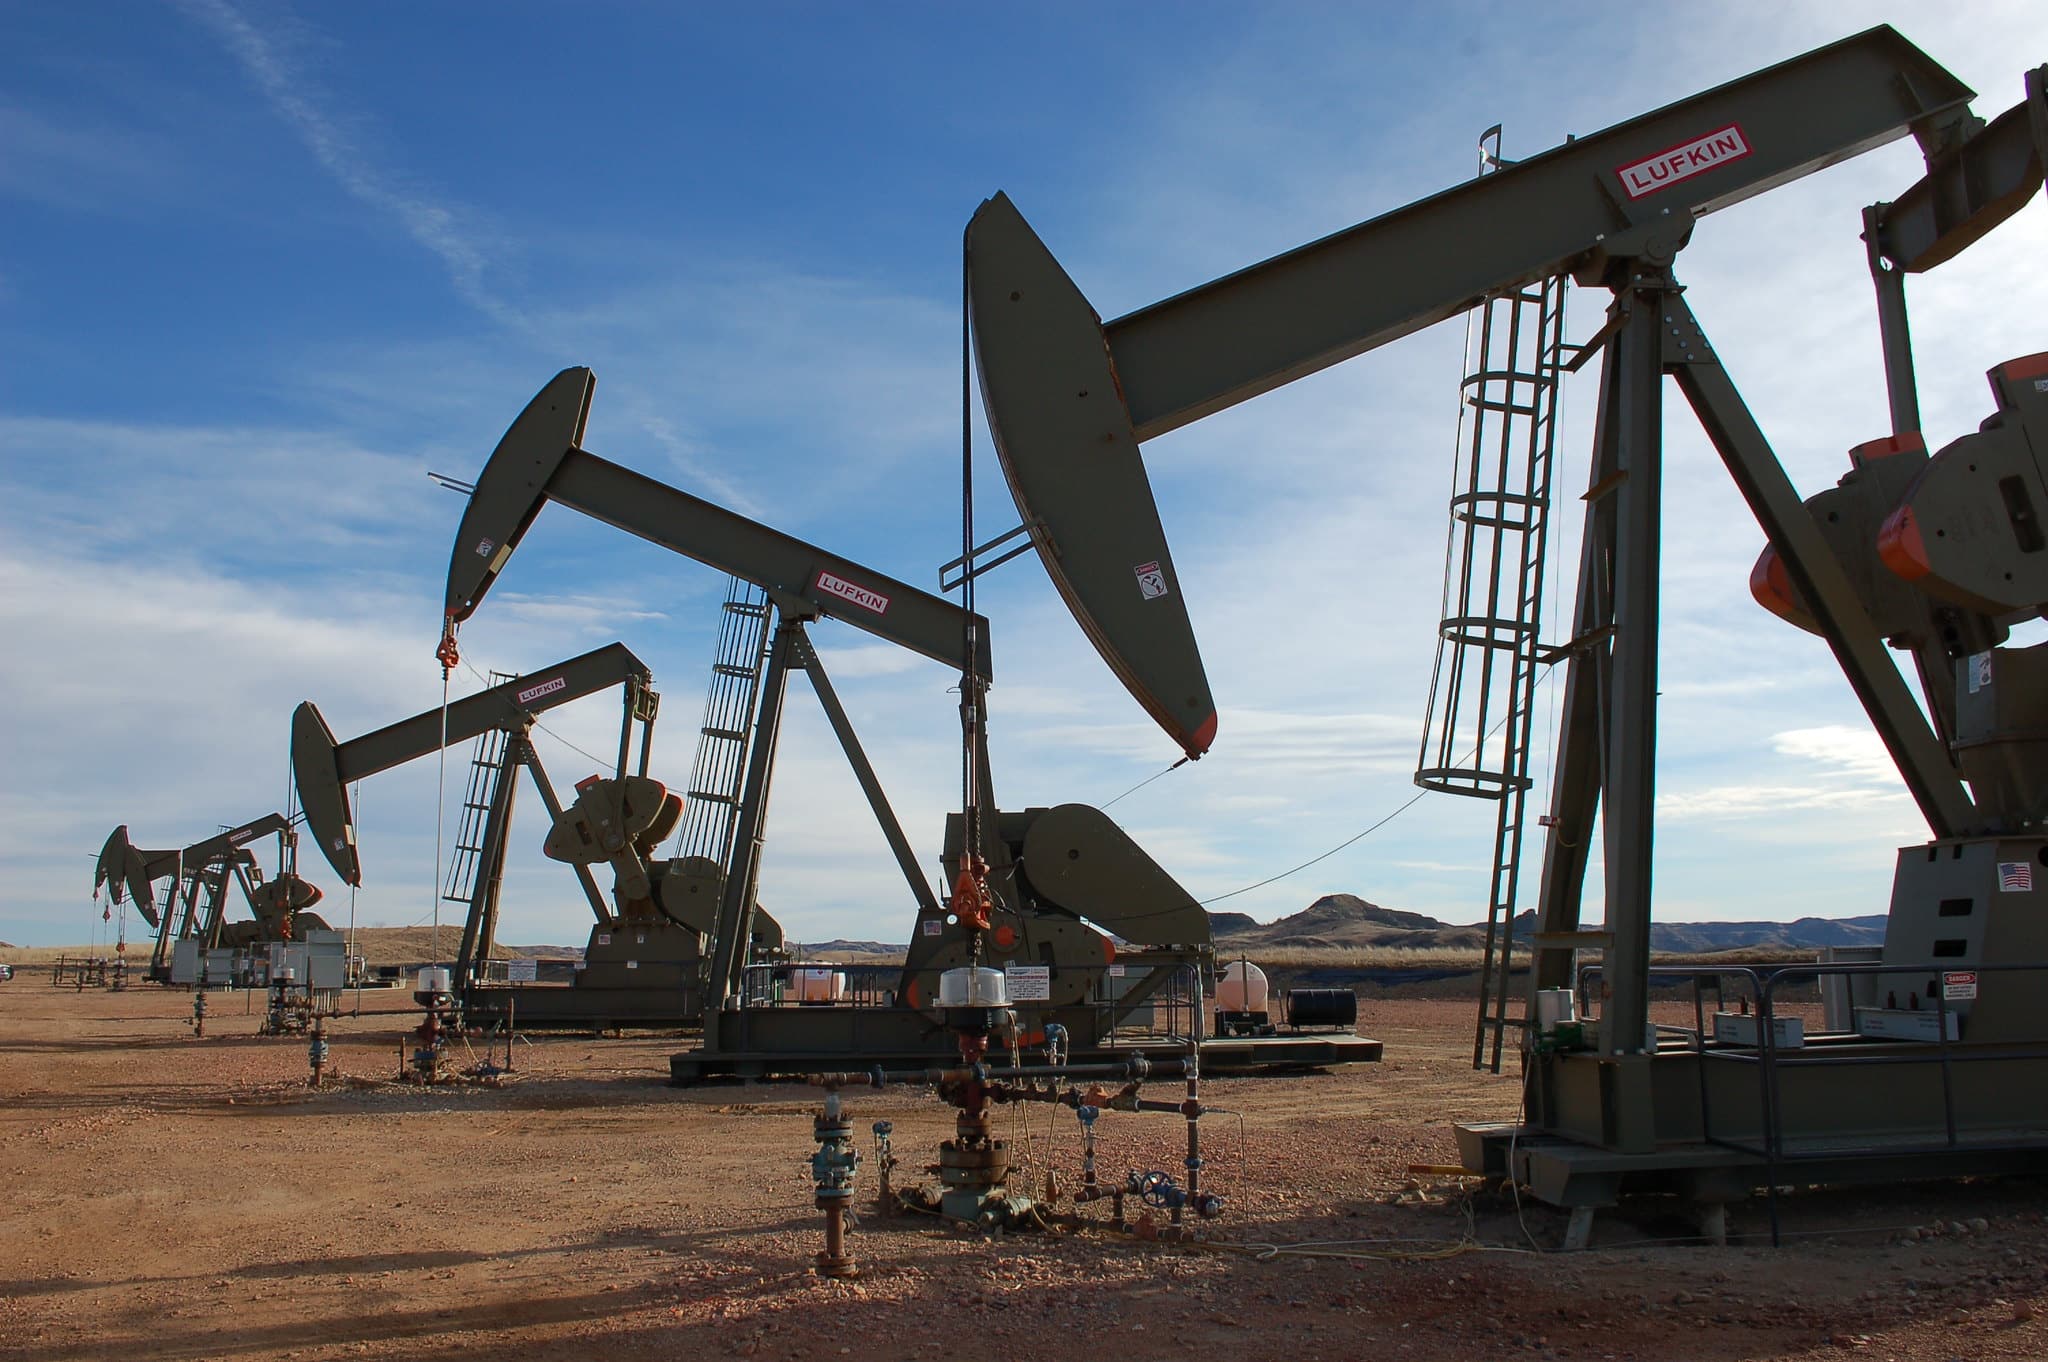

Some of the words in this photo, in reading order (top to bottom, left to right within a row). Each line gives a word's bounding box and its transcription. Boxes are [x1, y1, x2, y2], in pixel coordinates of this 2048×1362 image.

[1630, 135, 1738, 189] LUFKIN
[823, 577, 883, 608] LUFKIN
[521, 680, 563, 700] LUFKIN
